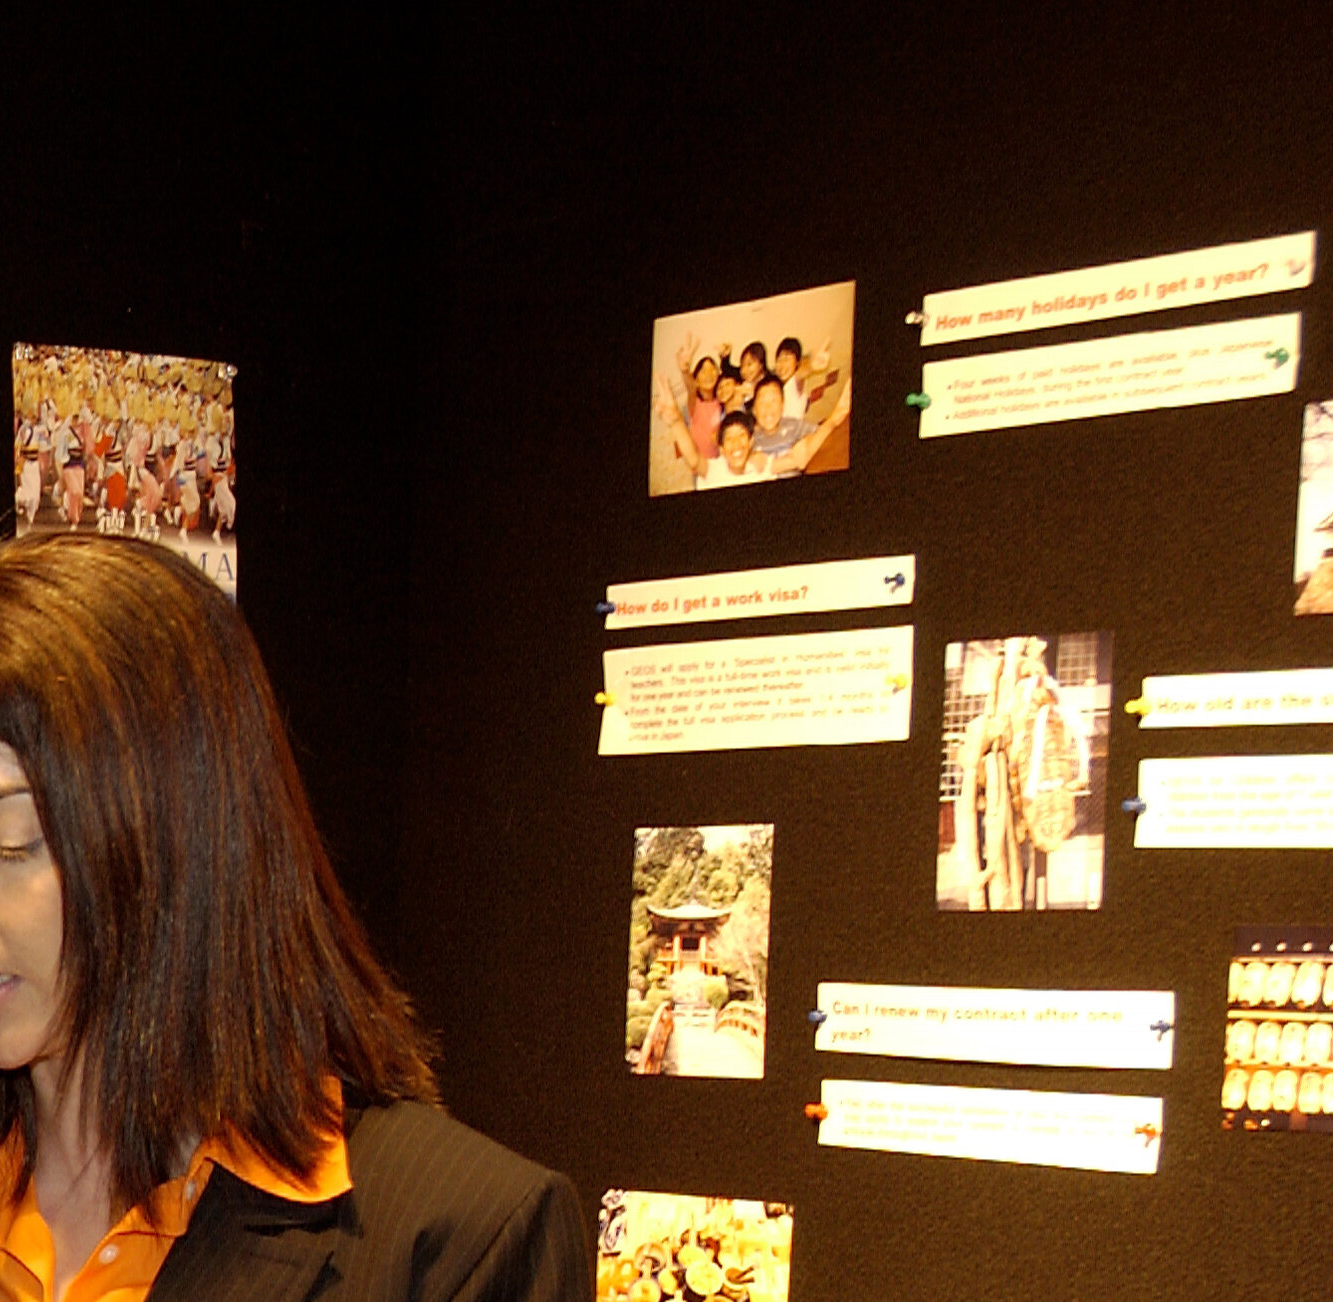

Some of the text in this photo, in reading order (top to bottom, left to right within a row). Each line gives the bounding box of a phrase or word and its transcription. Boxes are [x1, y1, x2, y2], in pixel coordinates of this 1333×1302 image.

[935, 263, 1270, 331] How many holidays do I get a year?
[617, 585, 809, 616] How do I get a work visa?
[832, 1000, 860, 1017] Can
[874, 1004, 920, 1020] renew
[924, 1006, 949, 1024] my
[954, 1006, 1027, 1022] contract
[1033, 1006, 1079, 1023] after
[1086, 1009, 1124, 1024] one
[830, 1027, 874, 1044] year?
